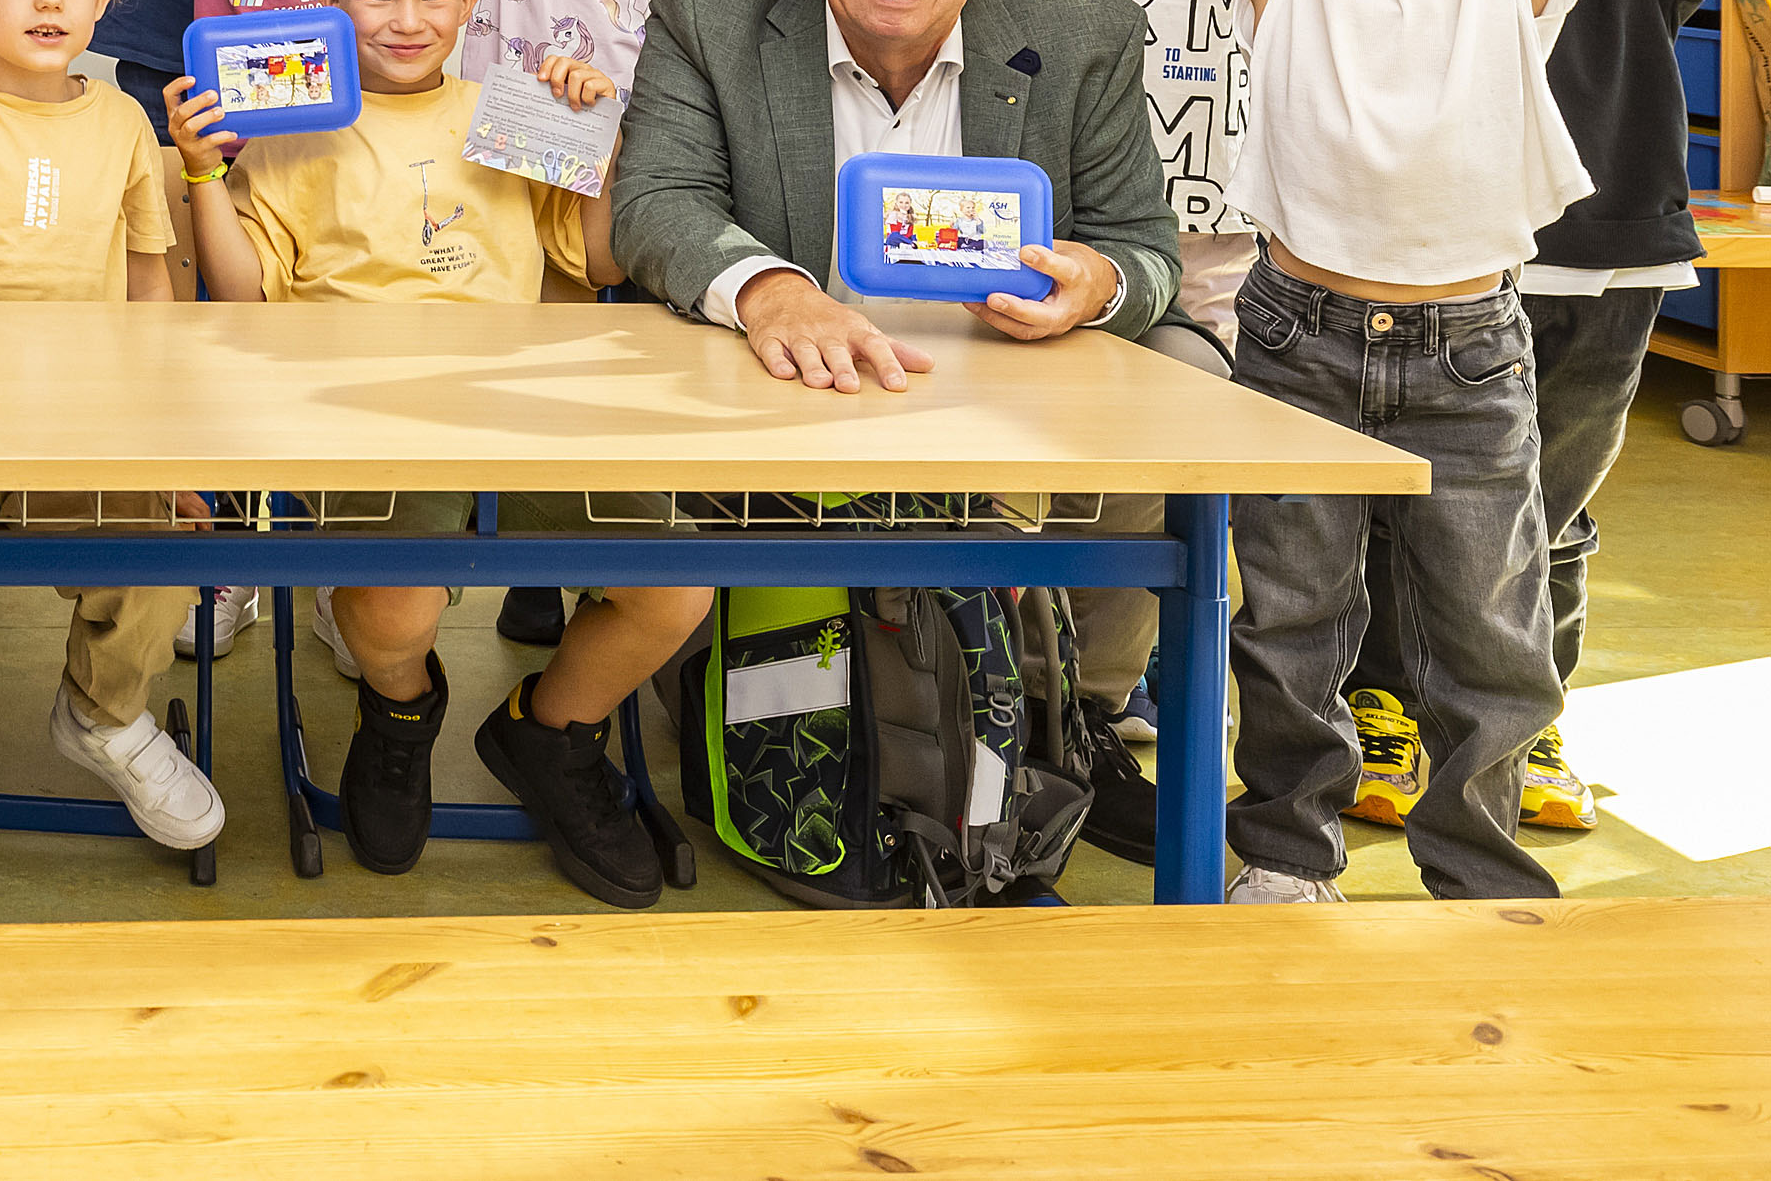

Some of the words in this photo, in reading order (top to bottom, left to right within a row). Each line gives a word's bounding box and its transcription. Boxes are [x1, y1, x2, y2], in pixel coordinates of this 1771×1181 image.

[1165, 47, 1181, 63] TO
[1162, 65, 1217, 83] STARTING
[36, 158, 51, 230] APPAREL
[989, 202, 1008, 210] ASH
[420, 256, 446, 265] GREAT
[447, 253, 465, 262] WAY
[430, 265, 451, 273] HAVE
